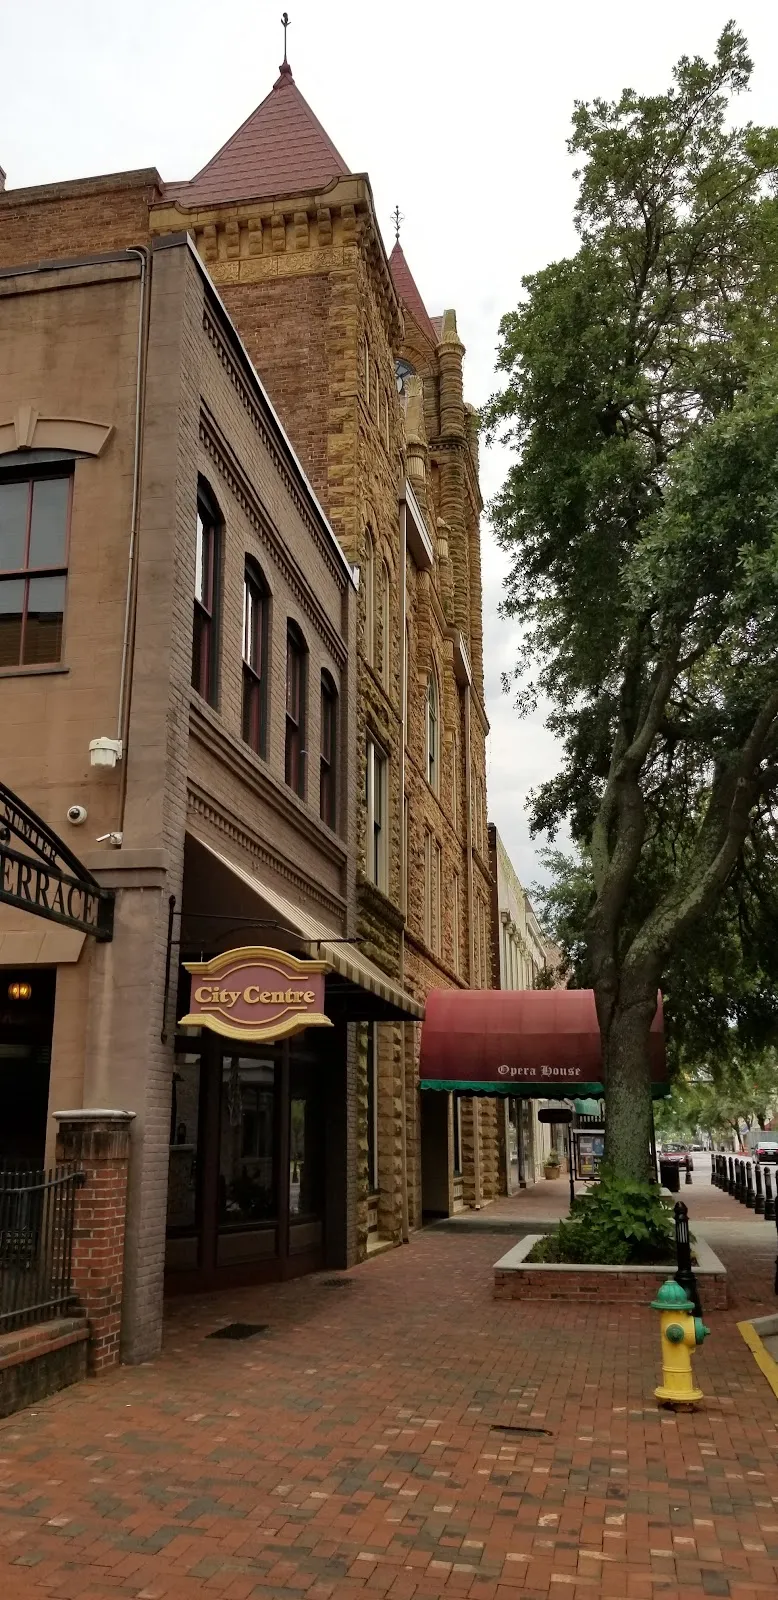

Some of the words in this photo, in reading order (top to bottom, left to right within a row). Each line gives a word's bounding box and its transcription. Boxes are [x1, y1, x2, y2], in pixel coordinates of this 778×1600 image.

[195, 986, 241, 1008] City
[243, 985, 315, 1004] Centre
[497, 1064, 537, 1077] Opera
[541, 1065, 581, 1077] House
